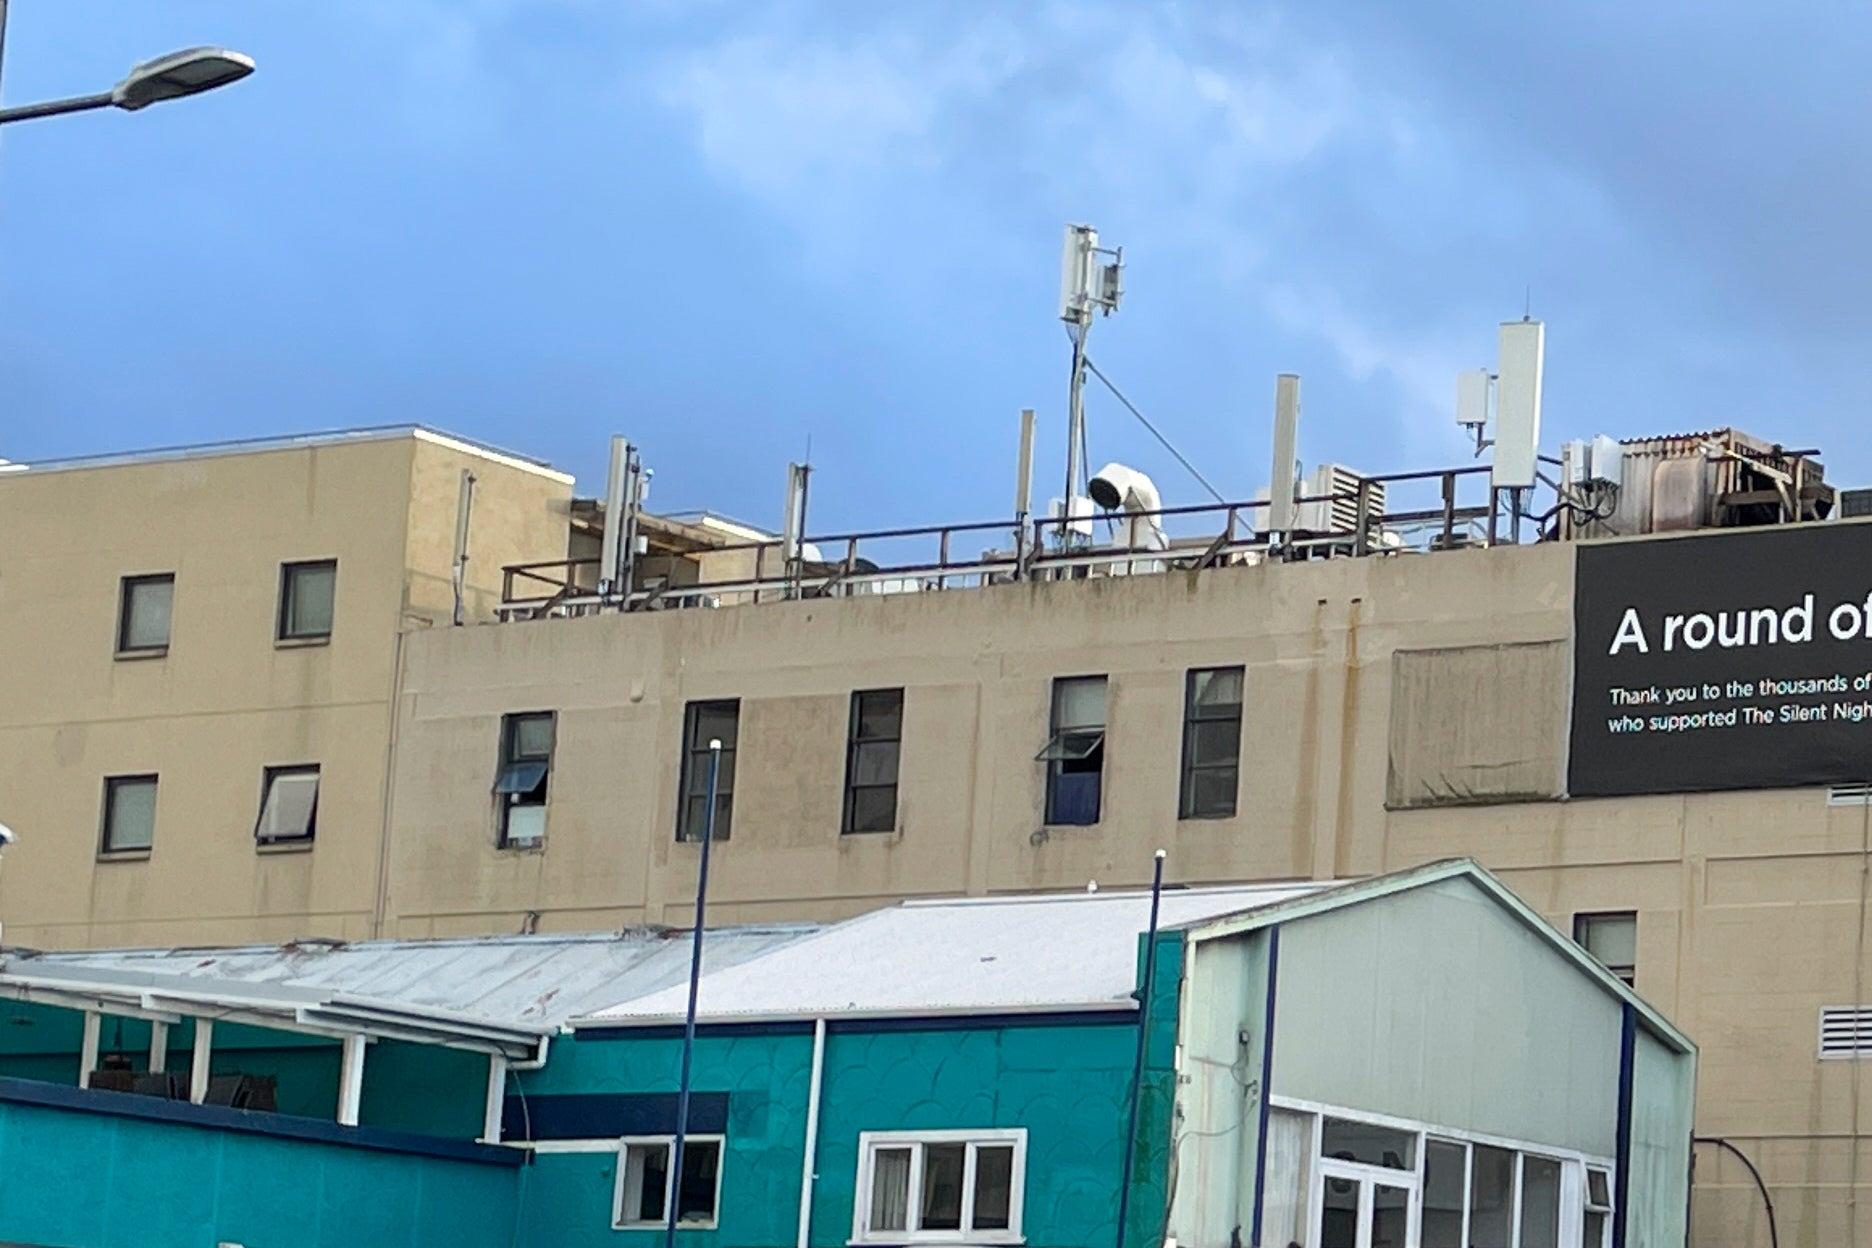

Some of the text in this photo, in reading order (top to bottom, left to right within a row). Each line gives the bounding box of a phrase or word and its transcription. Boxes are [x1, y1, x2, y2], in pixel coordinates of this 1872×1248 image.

[1609, 608, 1649, 655] A
[1662, 594, 1814, 652] round
[1609, 687, 1660, 706] Thank
[1665, 686, 1697, 707] you
[1702, 682, 1721, 700] to
[1726, 679, 1754, 698] the
[1759, 674, 1848, 697] thousands
[1853, 672, 1872, 691] of
[1608, 714, 1644, 734] who
[1648, 708, 1736, 733] supported
[1743, 706, 1775, 726] The
[1779, 703, 1827, 722] Silent
